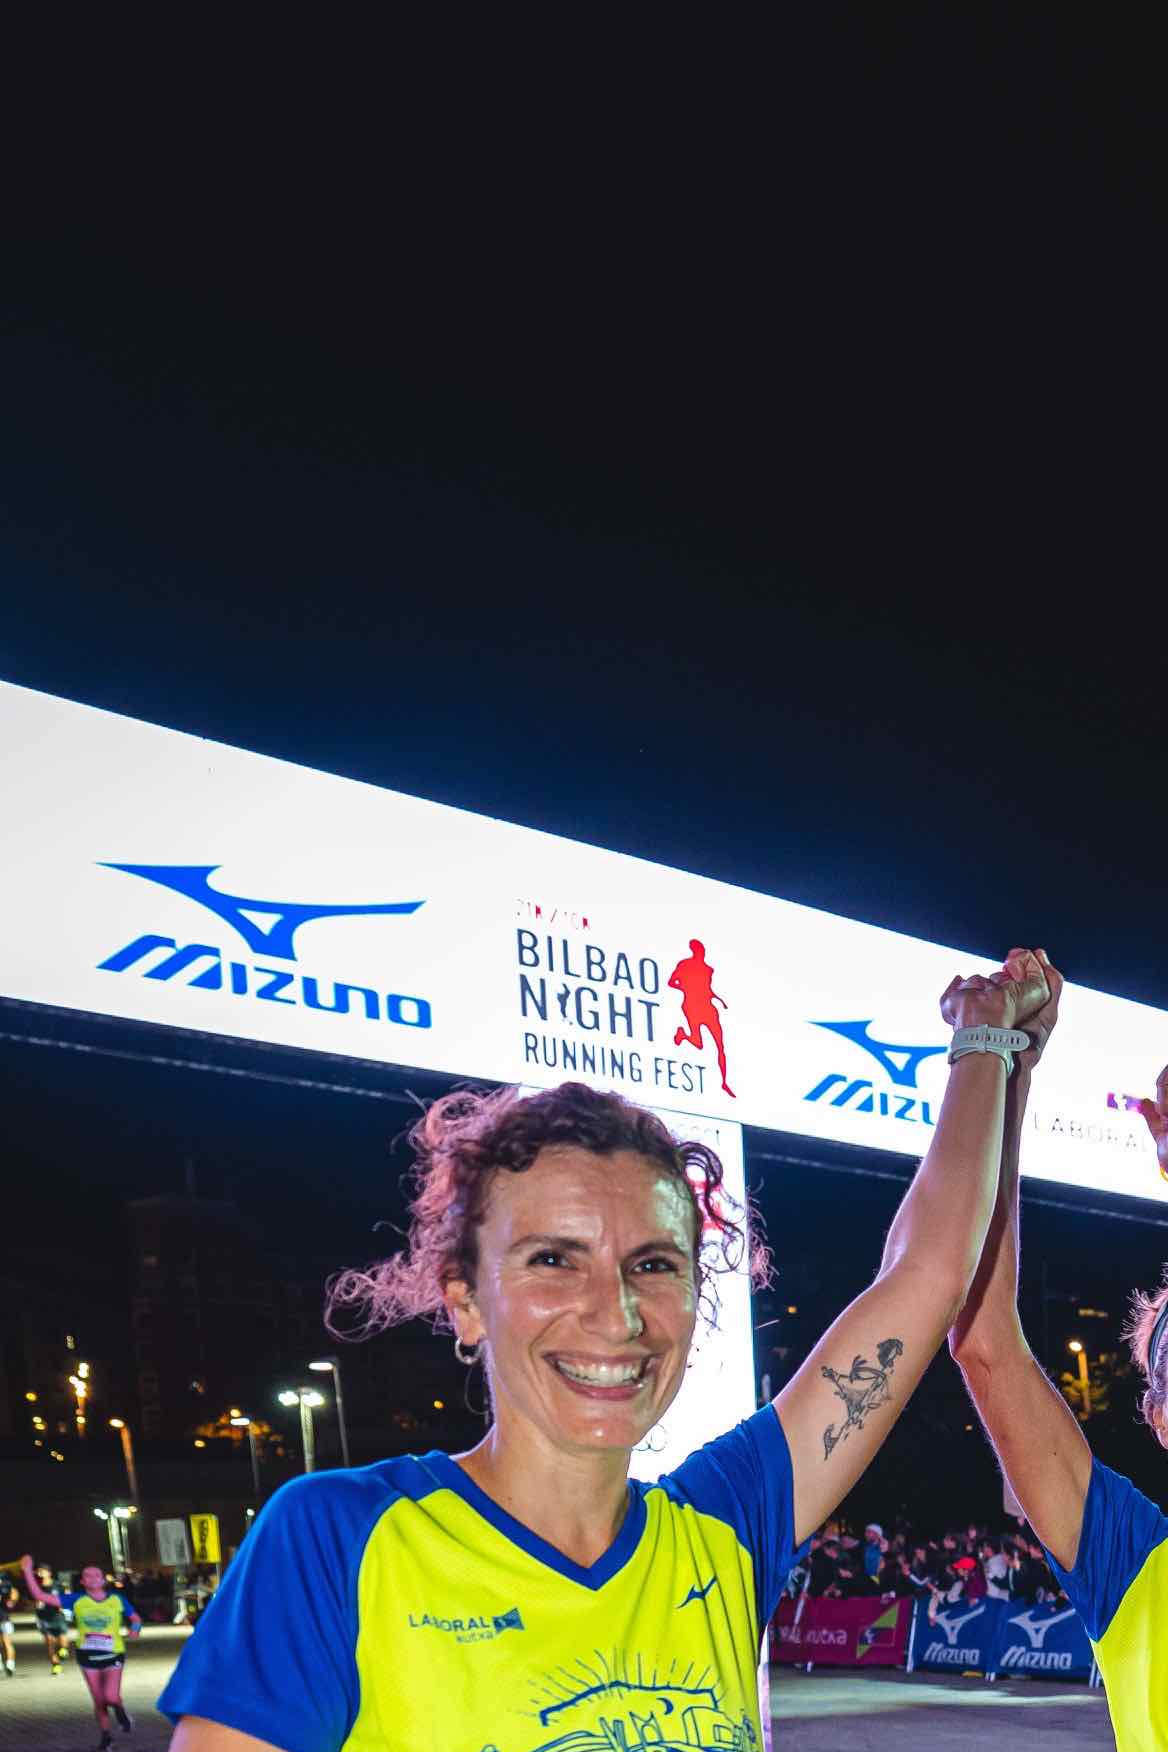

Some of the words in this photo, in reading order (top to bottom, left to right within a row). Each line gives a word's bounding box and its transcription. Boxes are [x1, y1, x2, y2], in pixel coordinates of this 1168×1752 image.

[96, 934, 432, 1029] MIZUNO
[517, 928, 660, 995] BILBAO
[524, 1032, 643, 1083] RUNNING
[654, 1057, 706, 1094] FEST
[924, 1641, 980, 1665] MIZUNO
[1000, 1646, 1073, 1670] MIZUNO
